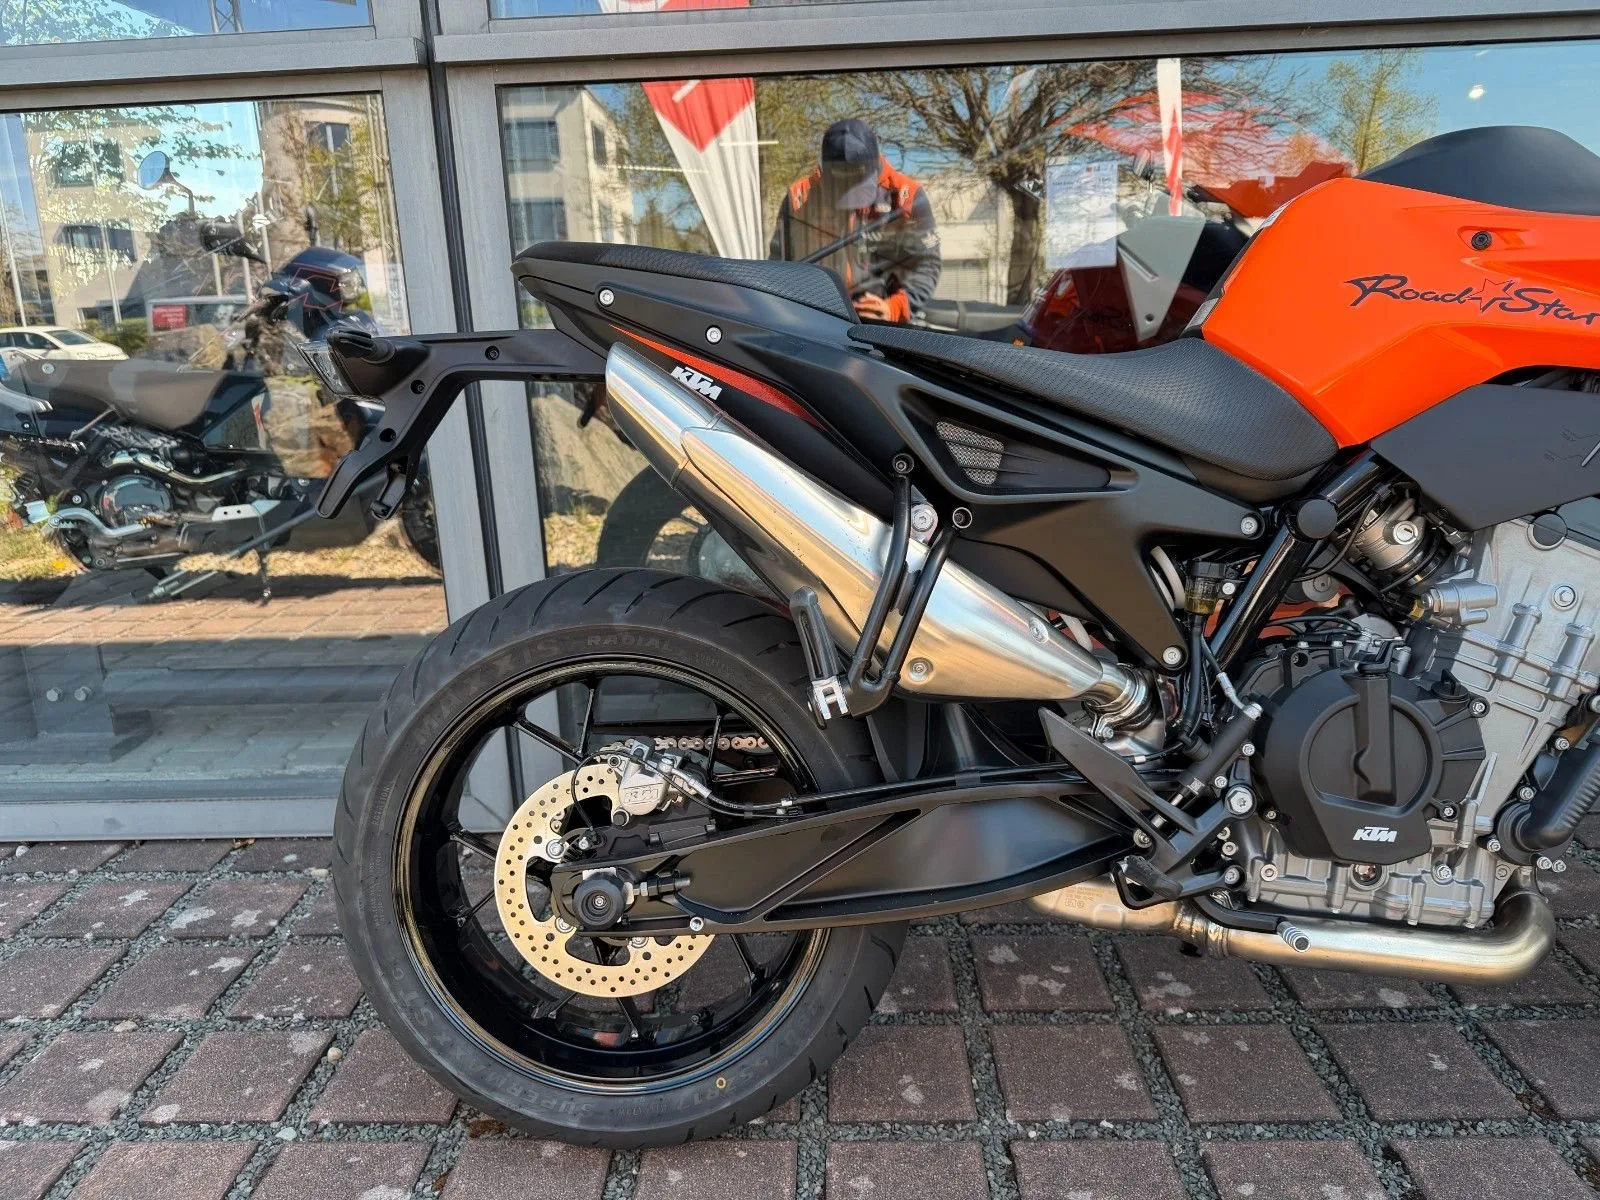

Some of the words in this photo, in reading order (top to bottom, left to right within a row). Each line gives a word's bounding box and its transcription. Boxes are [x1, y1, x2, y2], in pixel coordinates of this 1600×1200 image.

[1344, 273, 1475, 307] Road
[671, 366, 722, 400] KTM
[586, 634, 672, 653] RADIAL
[1353, 826, 1397, 842] KTM
